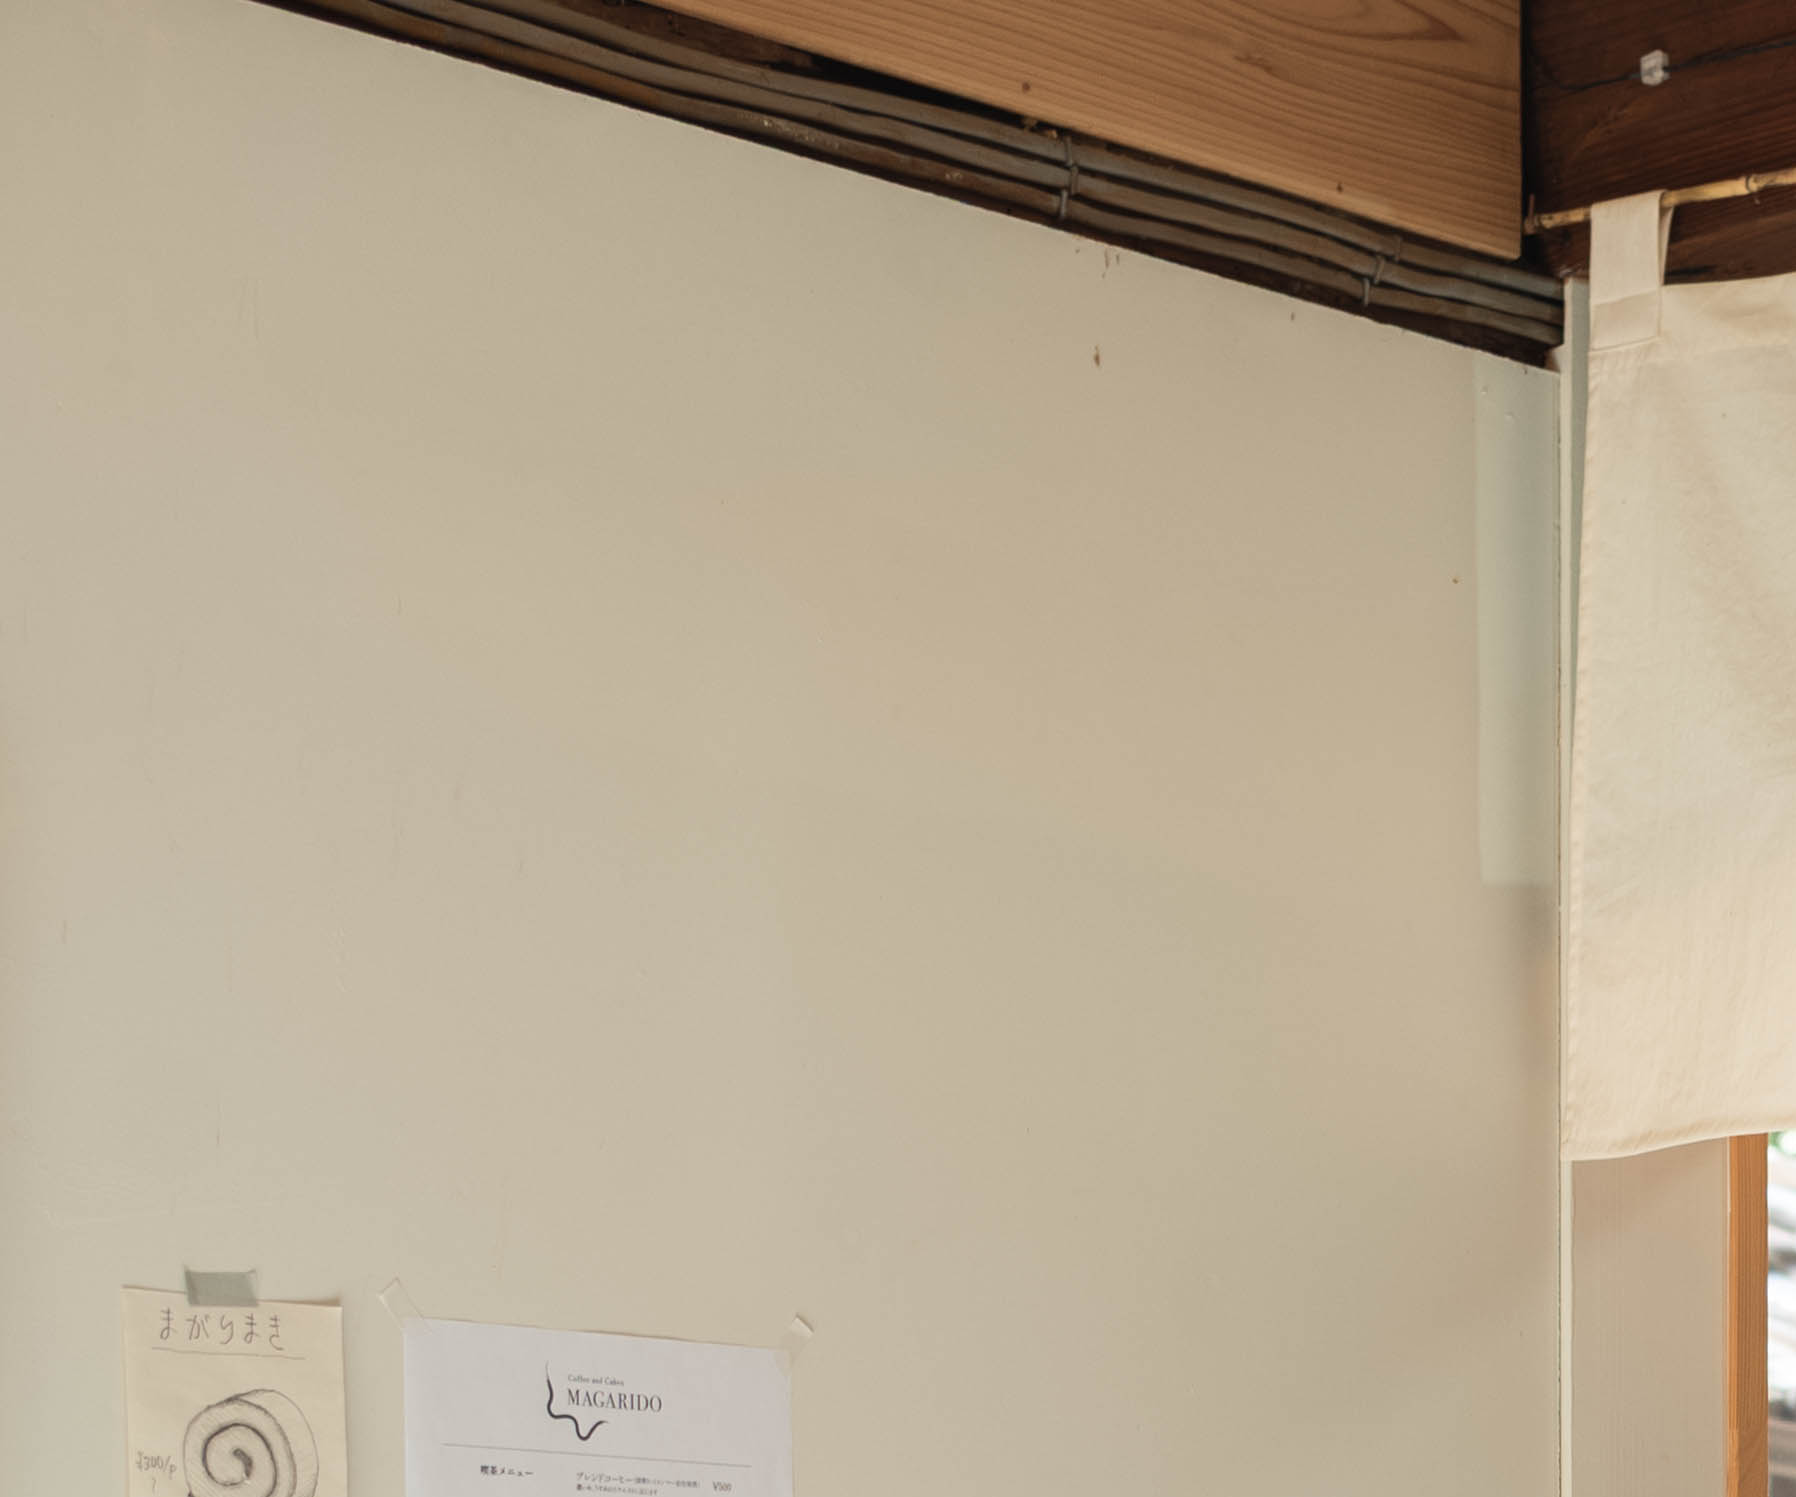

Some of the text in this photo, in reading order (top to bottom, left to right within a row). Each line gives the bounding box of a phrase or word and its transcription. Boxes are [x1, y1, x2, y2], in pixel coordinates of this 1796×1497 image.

[158, 1306, 285, 1352] まがりまき
[567, 1388, 663, 1413] MAGARIDO
[480, 1464, 534, 1478] 喫茶メニュー
